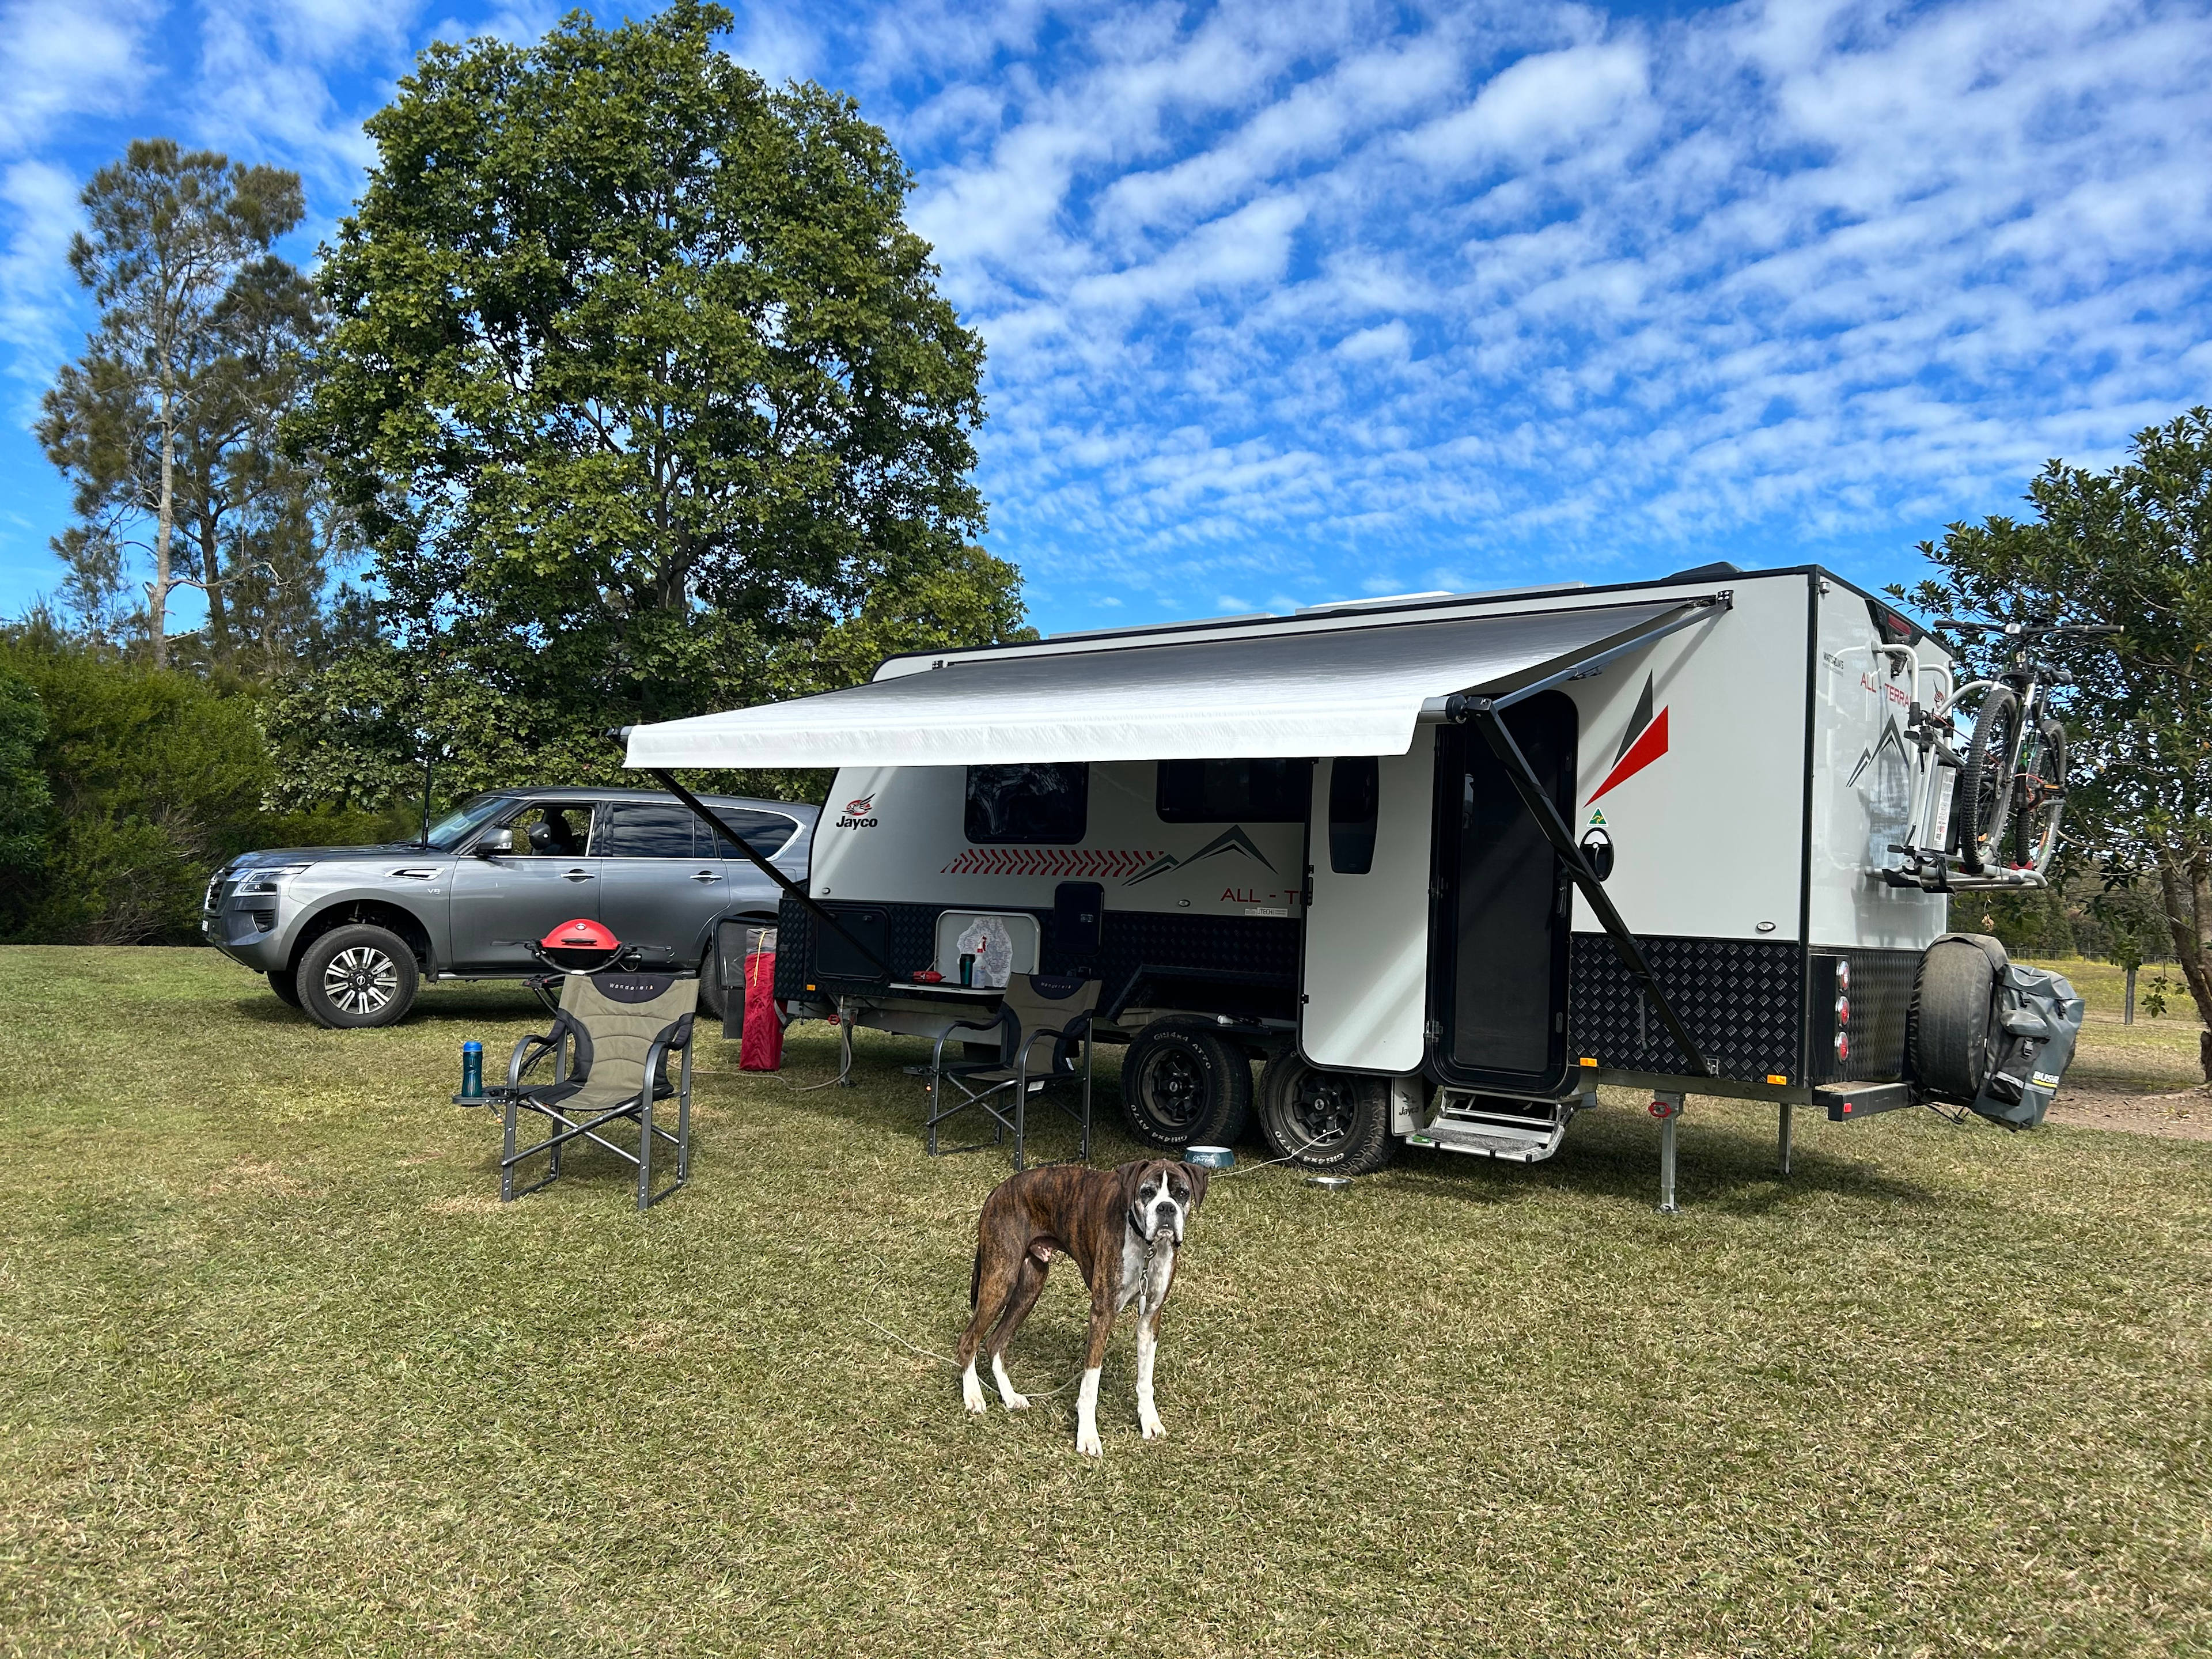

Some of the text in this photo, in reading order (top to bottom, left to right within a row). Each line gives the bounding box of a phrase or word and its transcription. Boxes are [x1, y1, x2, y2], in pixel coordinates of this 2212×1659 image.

[1860, 672, 1877, 694] ALL
[836, 816, 878, 830] Jayco
[1220, 888, 1261, 903] ALL
[1284, 890, 1302, 904] T
[1399, 1107, 1419, 1116] Jayco
